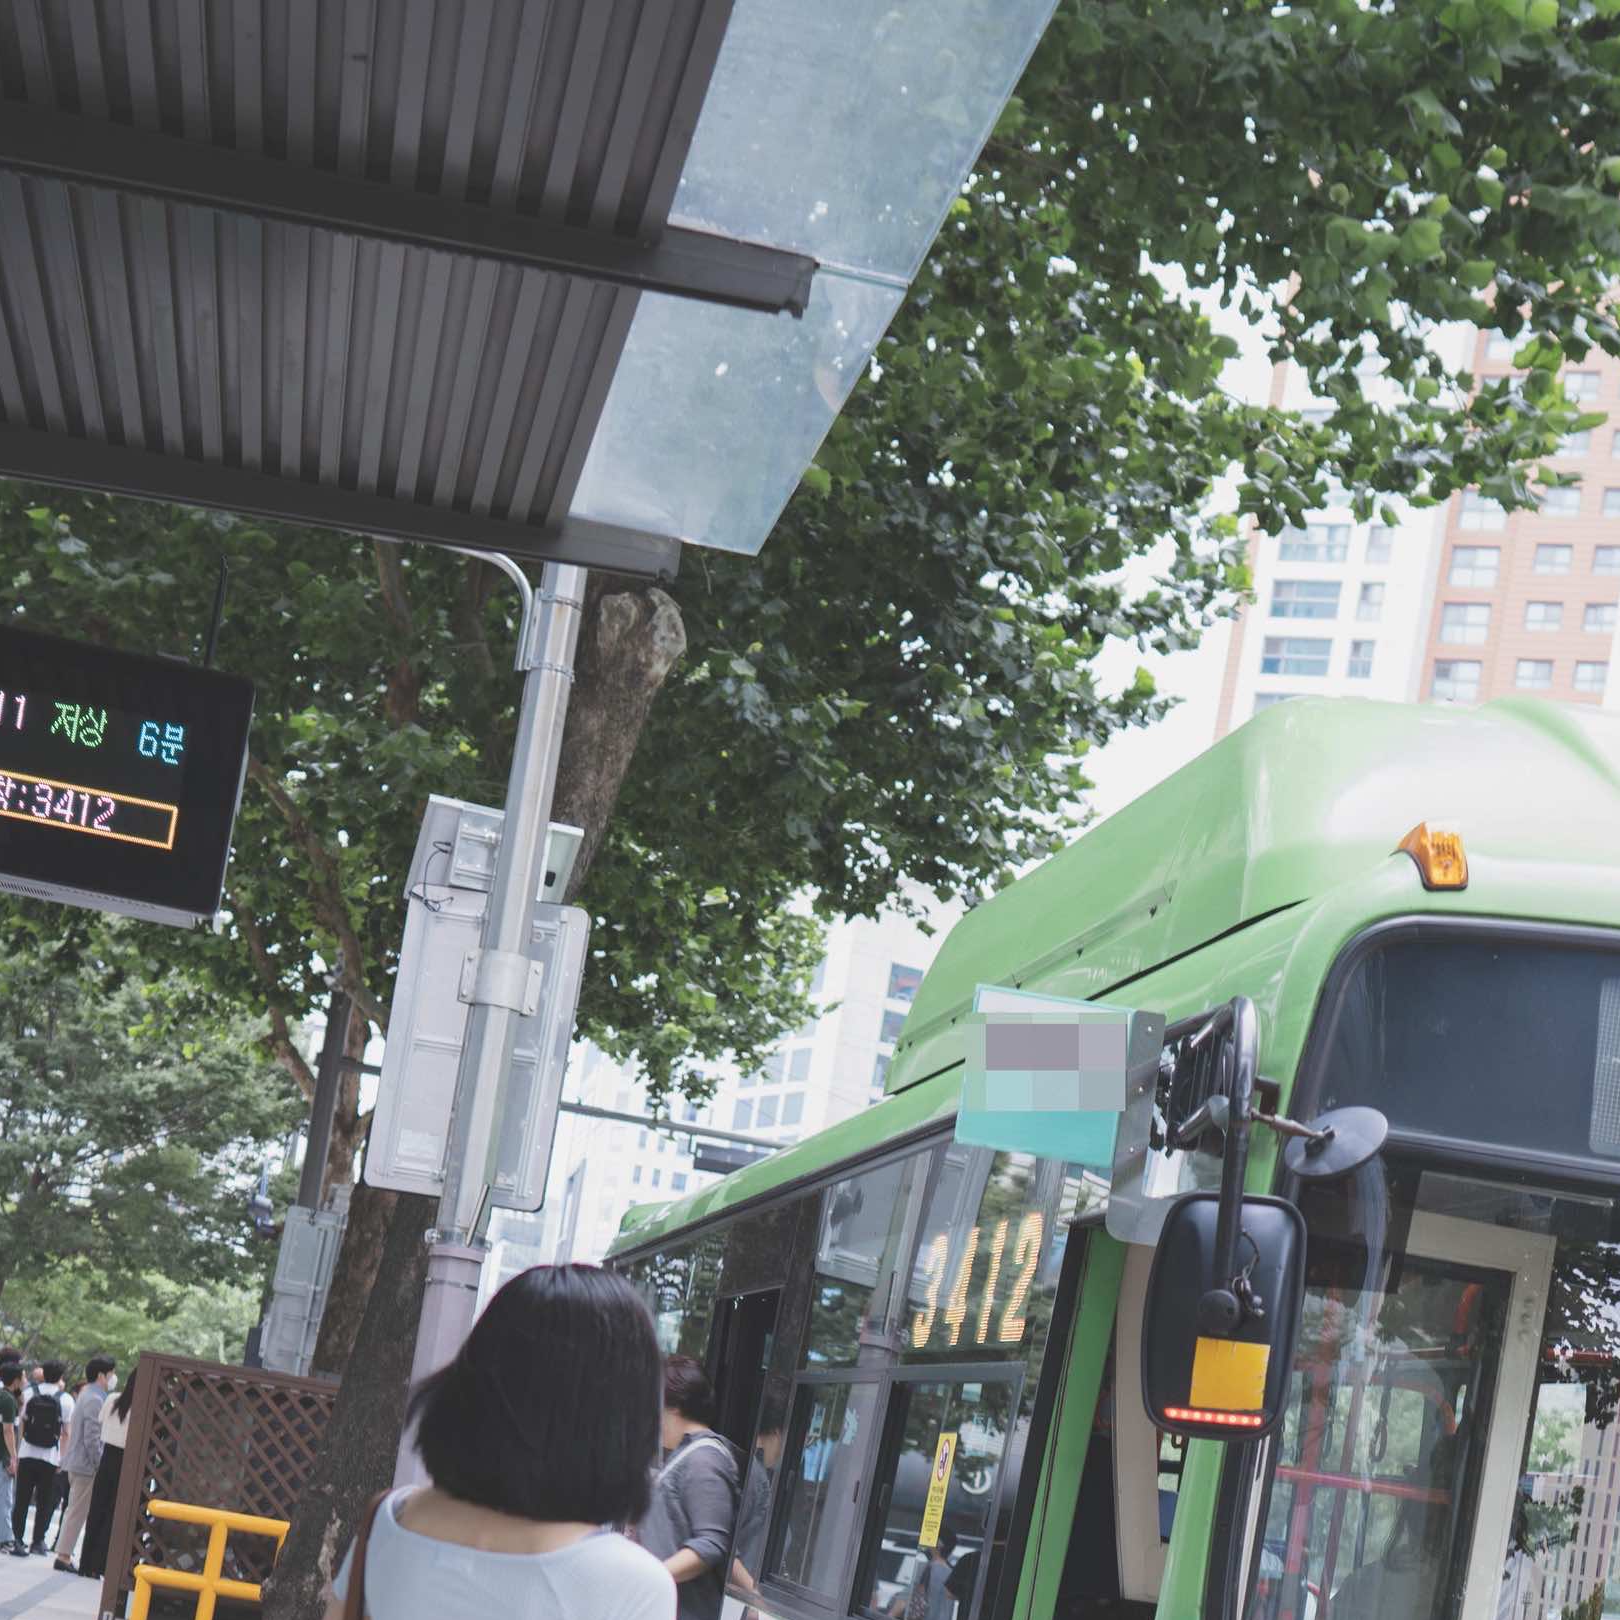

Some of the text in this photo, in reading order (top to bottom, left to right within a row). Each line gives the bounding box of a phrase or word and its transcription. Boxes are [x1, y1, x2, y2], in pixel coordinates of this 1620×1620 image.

[51, 699, 107, 748] 저상
[138, 720, 185, 765] 6분
[913, 1212, 1045, 1349] 3412
